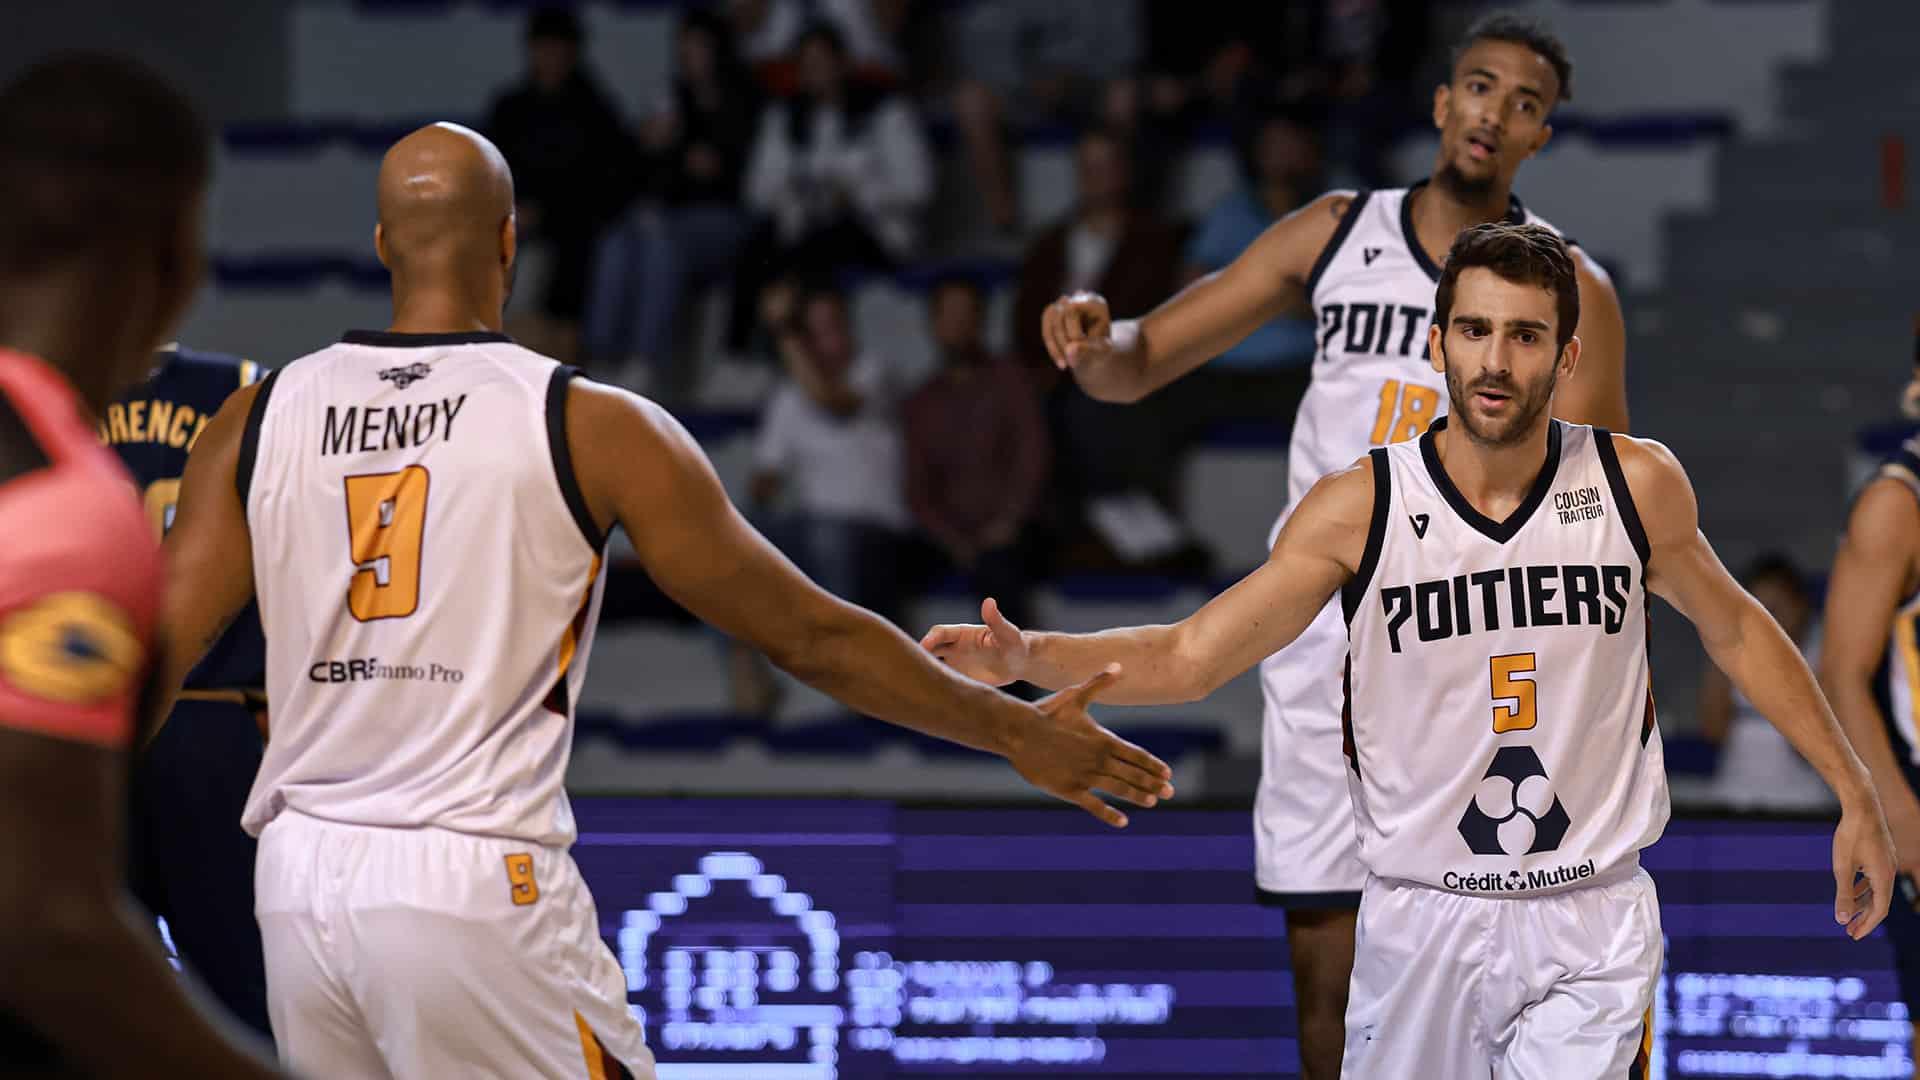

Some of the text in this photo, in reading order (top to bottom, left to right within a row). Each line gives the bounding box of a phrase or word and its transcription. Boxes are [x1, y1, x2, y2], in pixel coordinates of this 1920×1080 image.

[321, 394, 466, 456] MENDY
[1368, 377, 1441, 446] 18
[1554, 486, 1601, 510] COUSIN
[1557, 504, 1604, 525] TRAITEUR
[344, 463, 430, 623] 9
[1381, 564, 1632, 653] POITIERS
[430, 663, 464, 683] Pro
[1489, 652, 1537, 735] 5
[503, 853, 540, 906] 9
[1443, 858, 1595, 891] Crédit Mutuel
